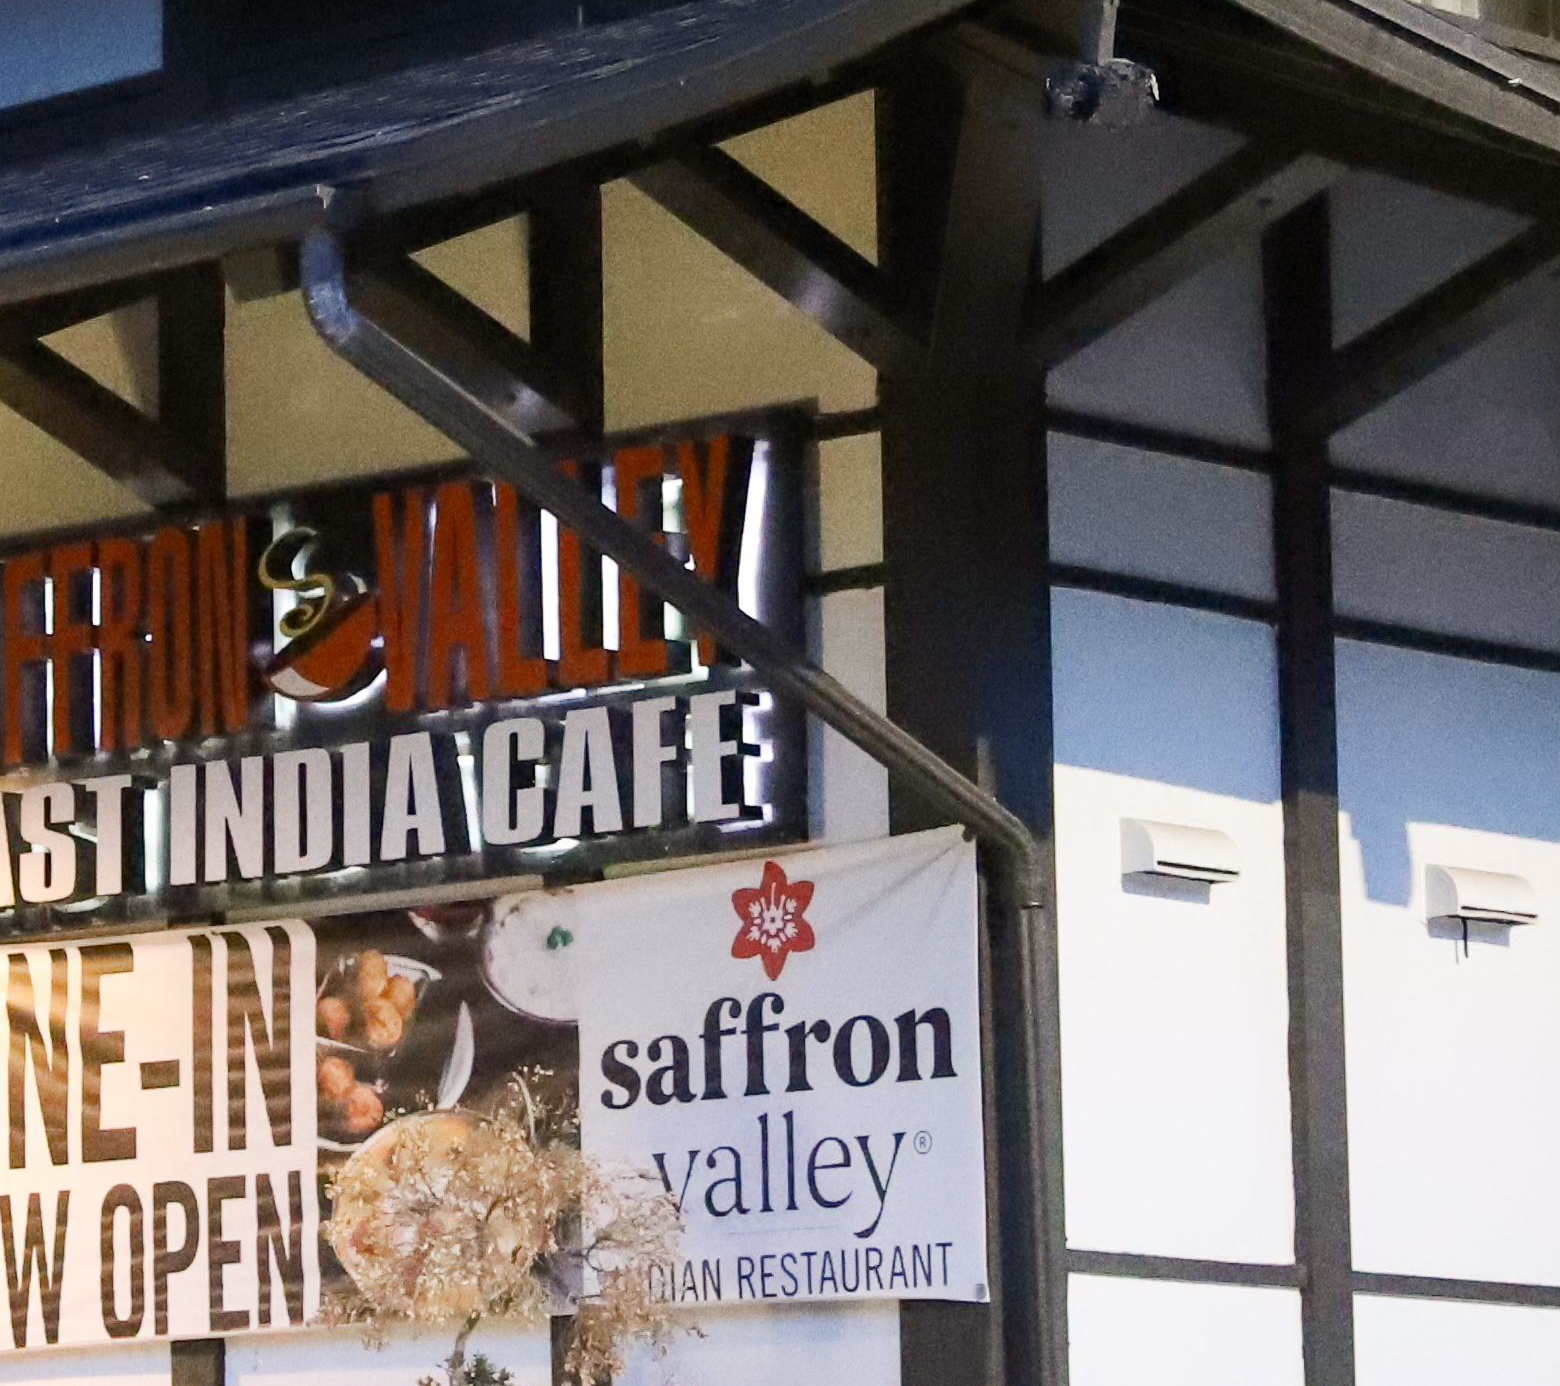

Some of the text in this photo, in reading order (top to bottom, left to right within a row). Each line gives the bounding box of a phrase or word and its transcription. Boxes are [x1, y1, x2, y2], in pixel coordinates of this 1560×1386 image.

[373, 435, 729, 711] VALLEY
[170, 731, 446, 886] INDIA
[483, 690, 740, 845] CAFE
[600, 993, 958, 1109] saffron
[652, 1110, 906, 1238] valley
[101, 1171, 304, 1338] OPEN
[648, 1243, 953, 1302] DIAN RESTAURANT
